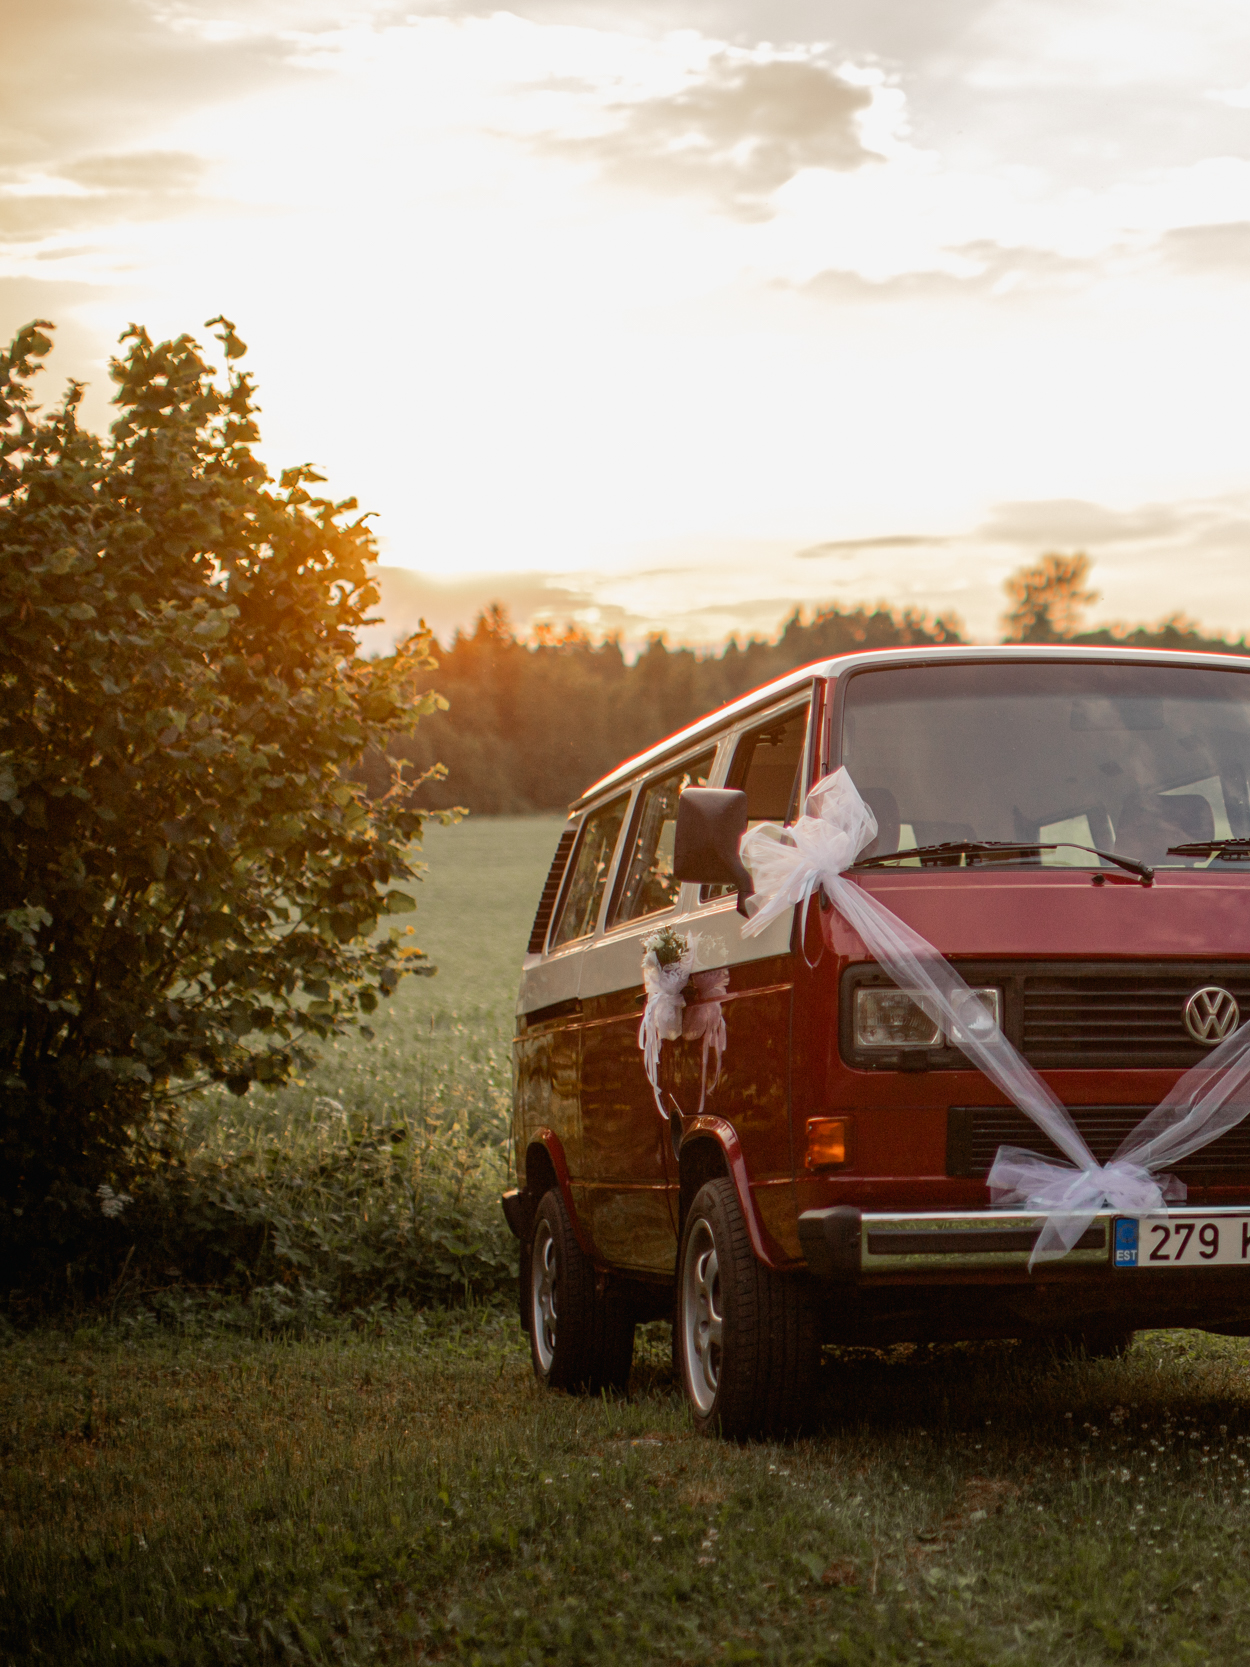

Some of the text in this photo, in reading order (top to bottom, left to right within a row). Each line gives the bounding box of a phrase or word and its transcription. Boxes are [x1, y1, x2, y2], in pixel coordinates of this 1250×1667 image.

[1187, 988, 1238, 1043] VW
[1116, 1250, 1138, 1261] EST
[1149, 1223, 1219, 1261] 279
